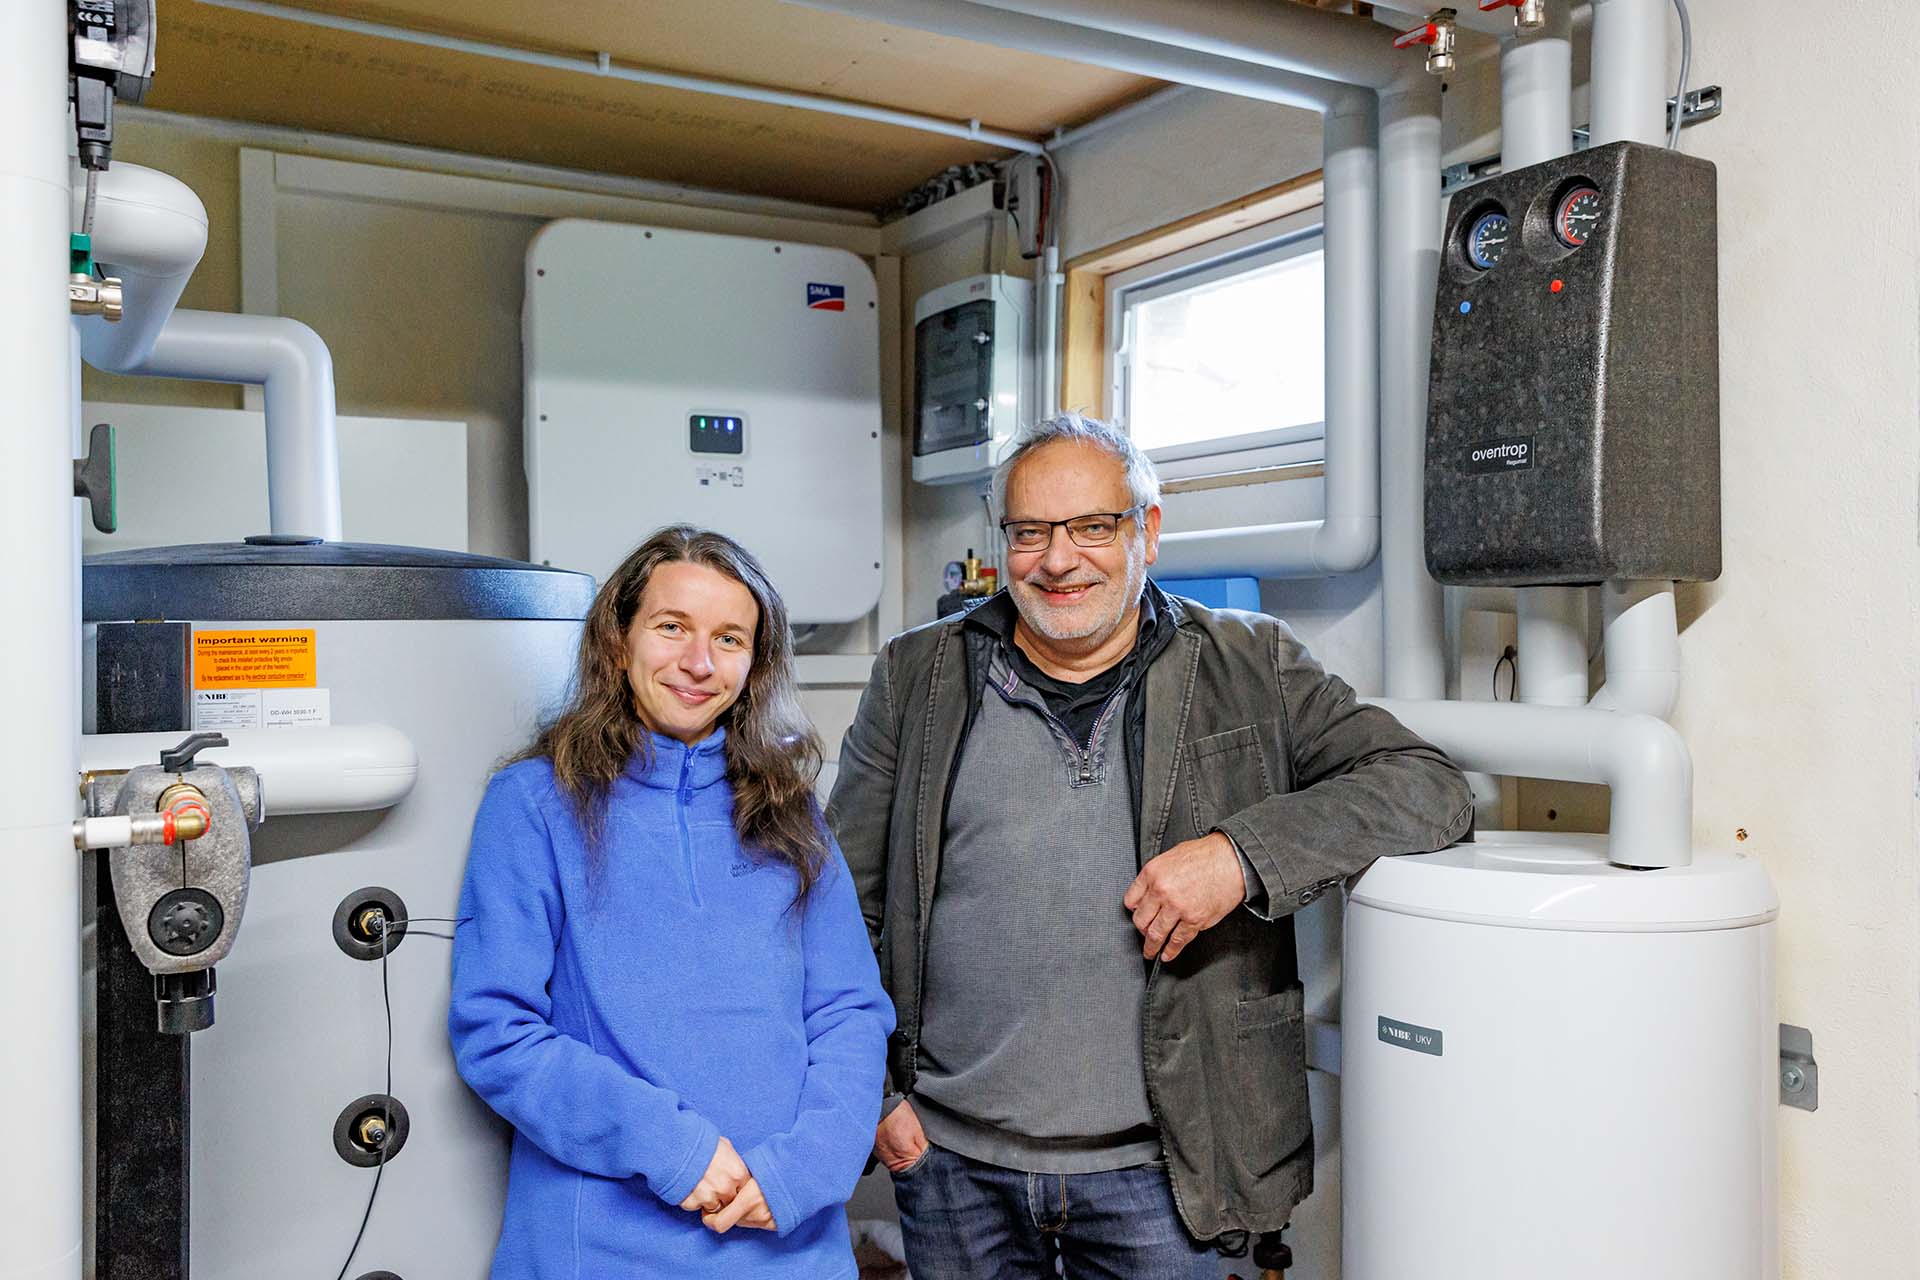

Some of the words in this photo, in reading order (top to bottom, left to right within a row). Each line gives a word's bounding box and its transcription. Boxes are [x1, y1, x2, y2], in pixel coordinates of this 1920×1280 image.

[810, 285, 831, 297] SMA
[1472, 443, 1528, 462] oventrop
[198, 637, 256, 645] Important
[259, 635, 308, 644] warning
[1388, 1026, 1411, 1041] NIBE
[1415, 1034, 1433, 1046] UKV
